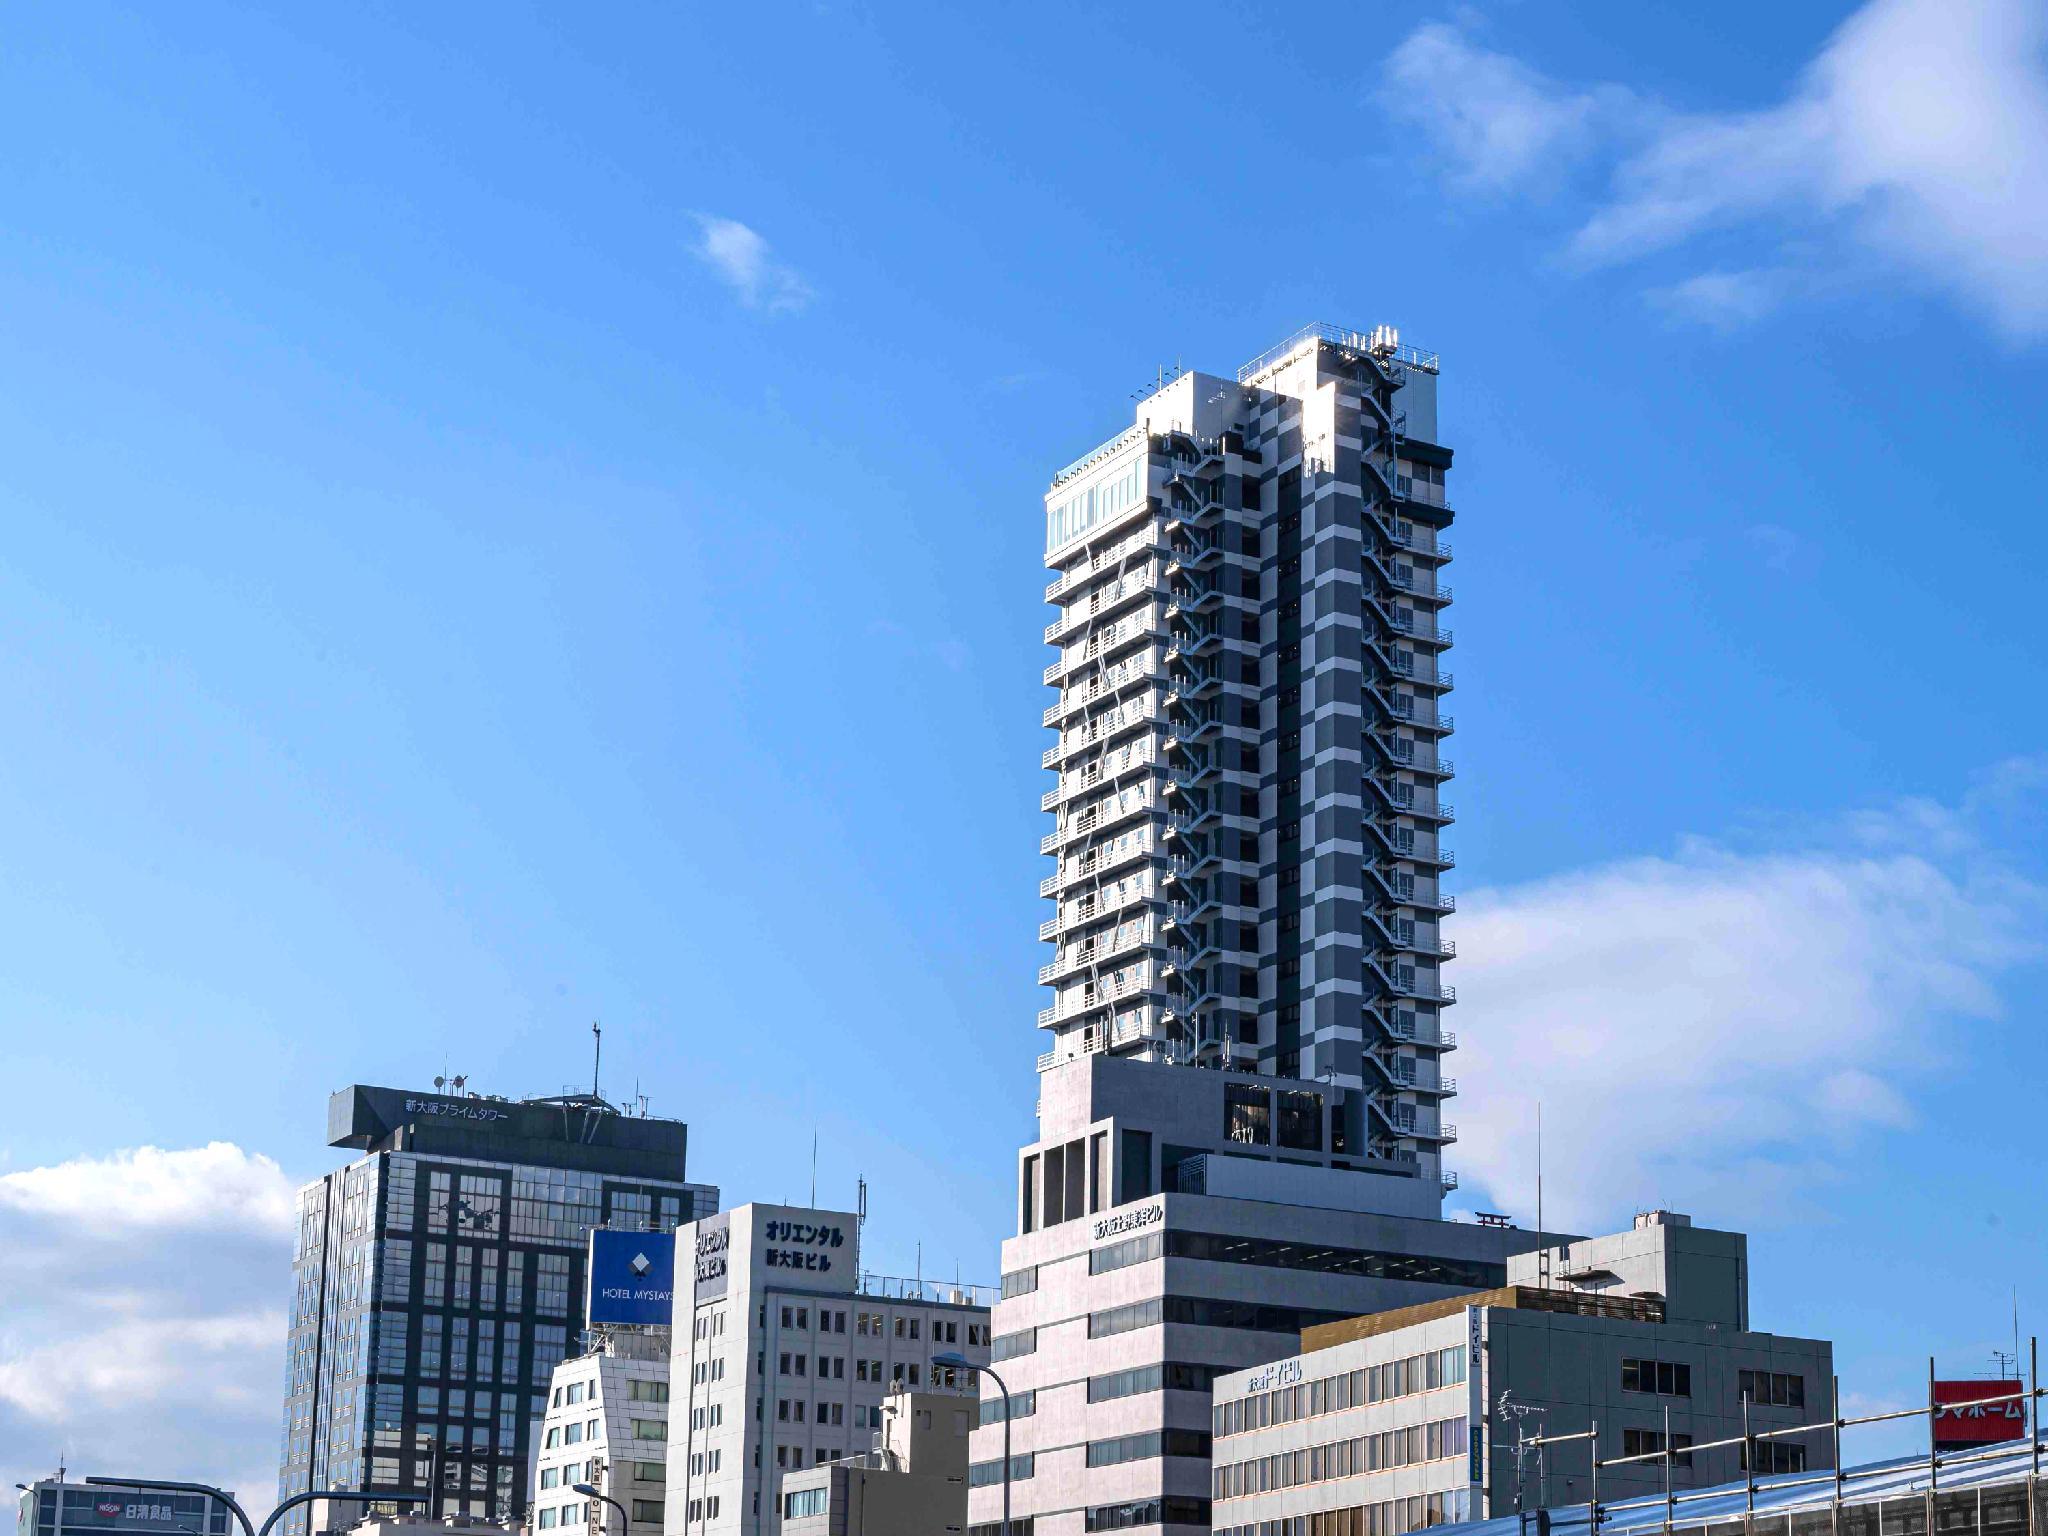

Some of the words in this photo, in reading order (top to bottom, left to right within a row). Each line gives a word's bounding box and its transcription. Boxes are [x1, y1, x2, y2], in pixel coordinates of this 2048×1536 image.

[405, 1100, 508, 1120] 新大阪プライムタワー
[766, 1220, 844, 1248] オリエンタル
[766, 1249, 832, 1273] 新大阪ビル
[602, 1288, 630, 1299] HOTEL
[99, 1504, 121, 1513] NISSIN
[126, 1504, 172, 1521] 日清食品
